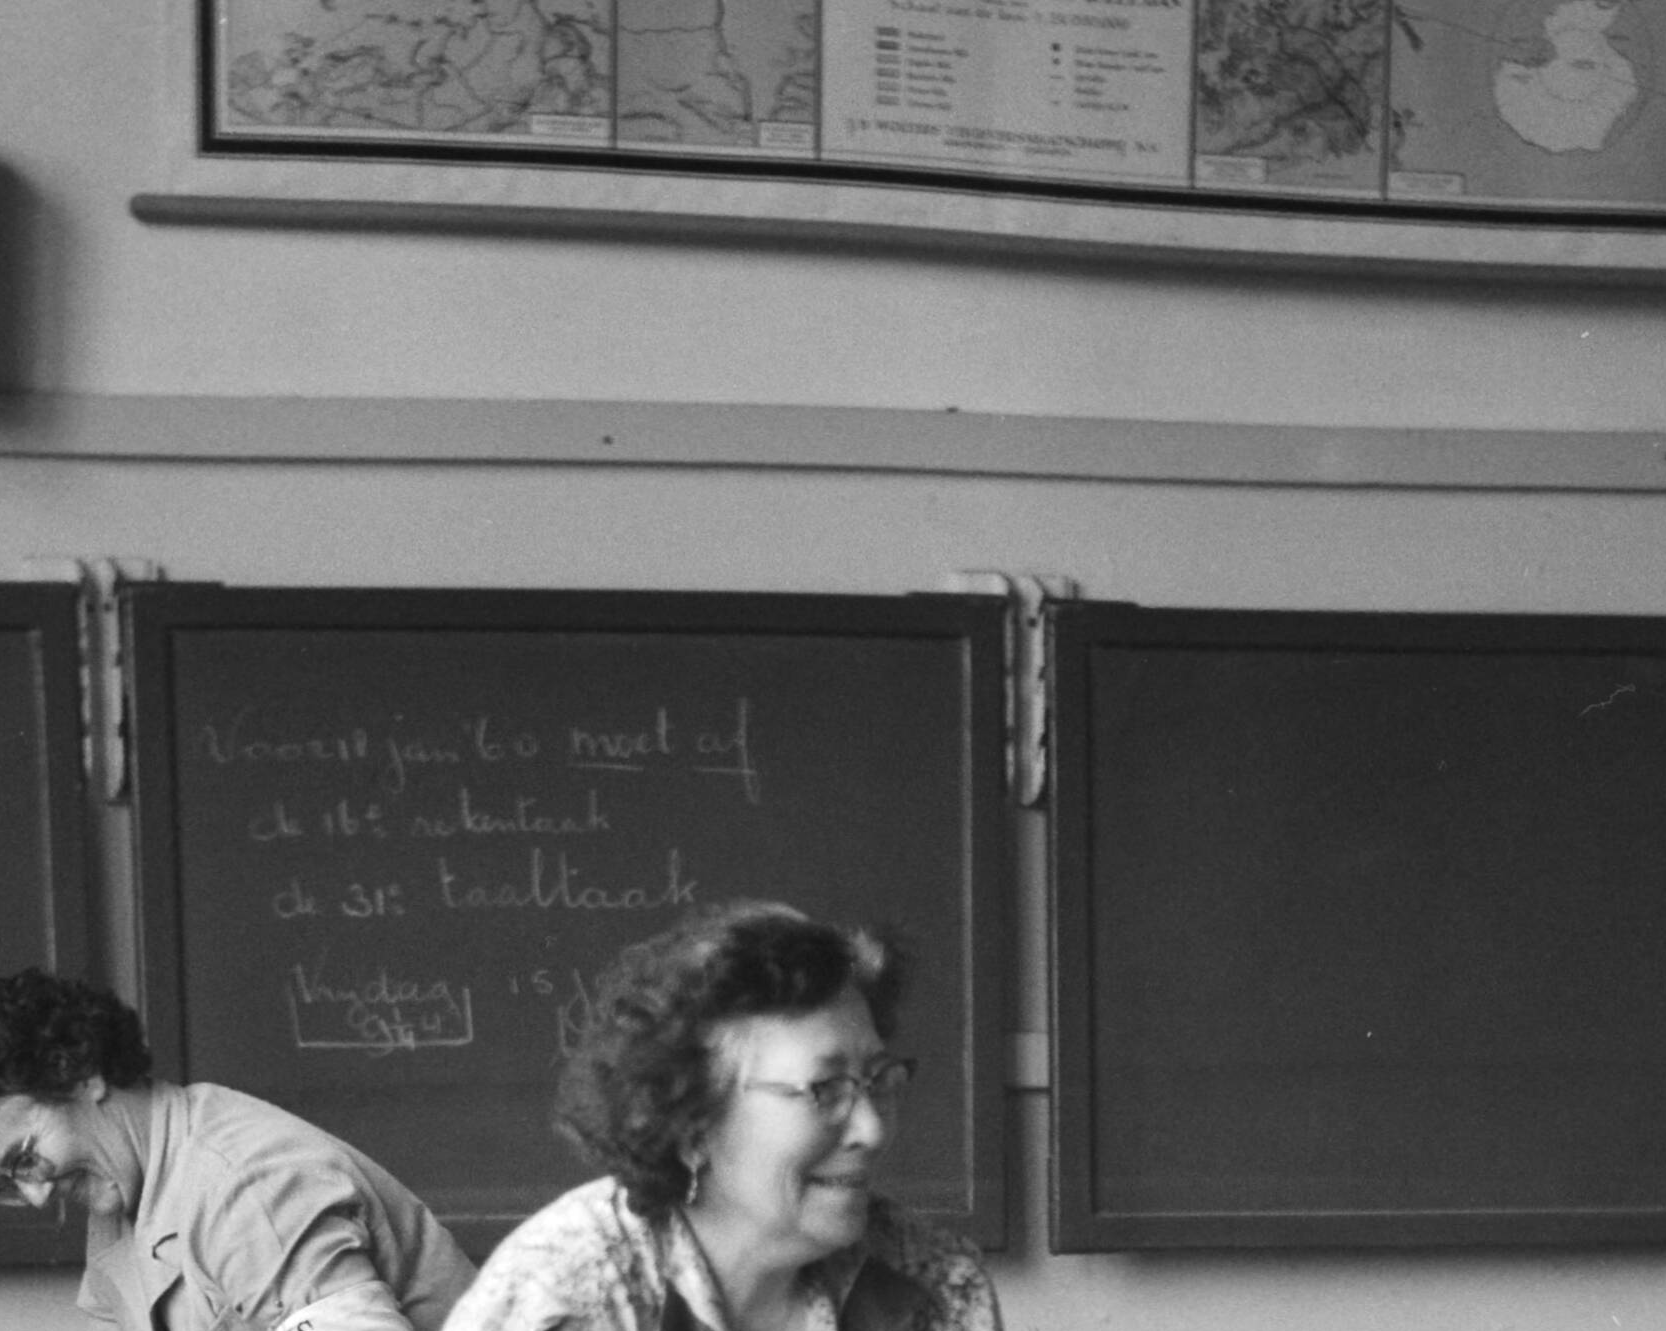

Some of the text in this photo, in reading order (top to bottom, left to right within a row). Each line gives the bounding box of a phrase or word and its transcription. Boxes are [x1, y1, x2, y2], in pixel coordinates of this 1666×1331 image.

[203, 704, 334, 764] Voor
[569, 705, 671, 760] moet
[696, 697, 761, 805] af
[410, 785, 613, 839] rekentaak
[271, 876, 321, 919] de
[435, 845, 700, 911] taaltaak
